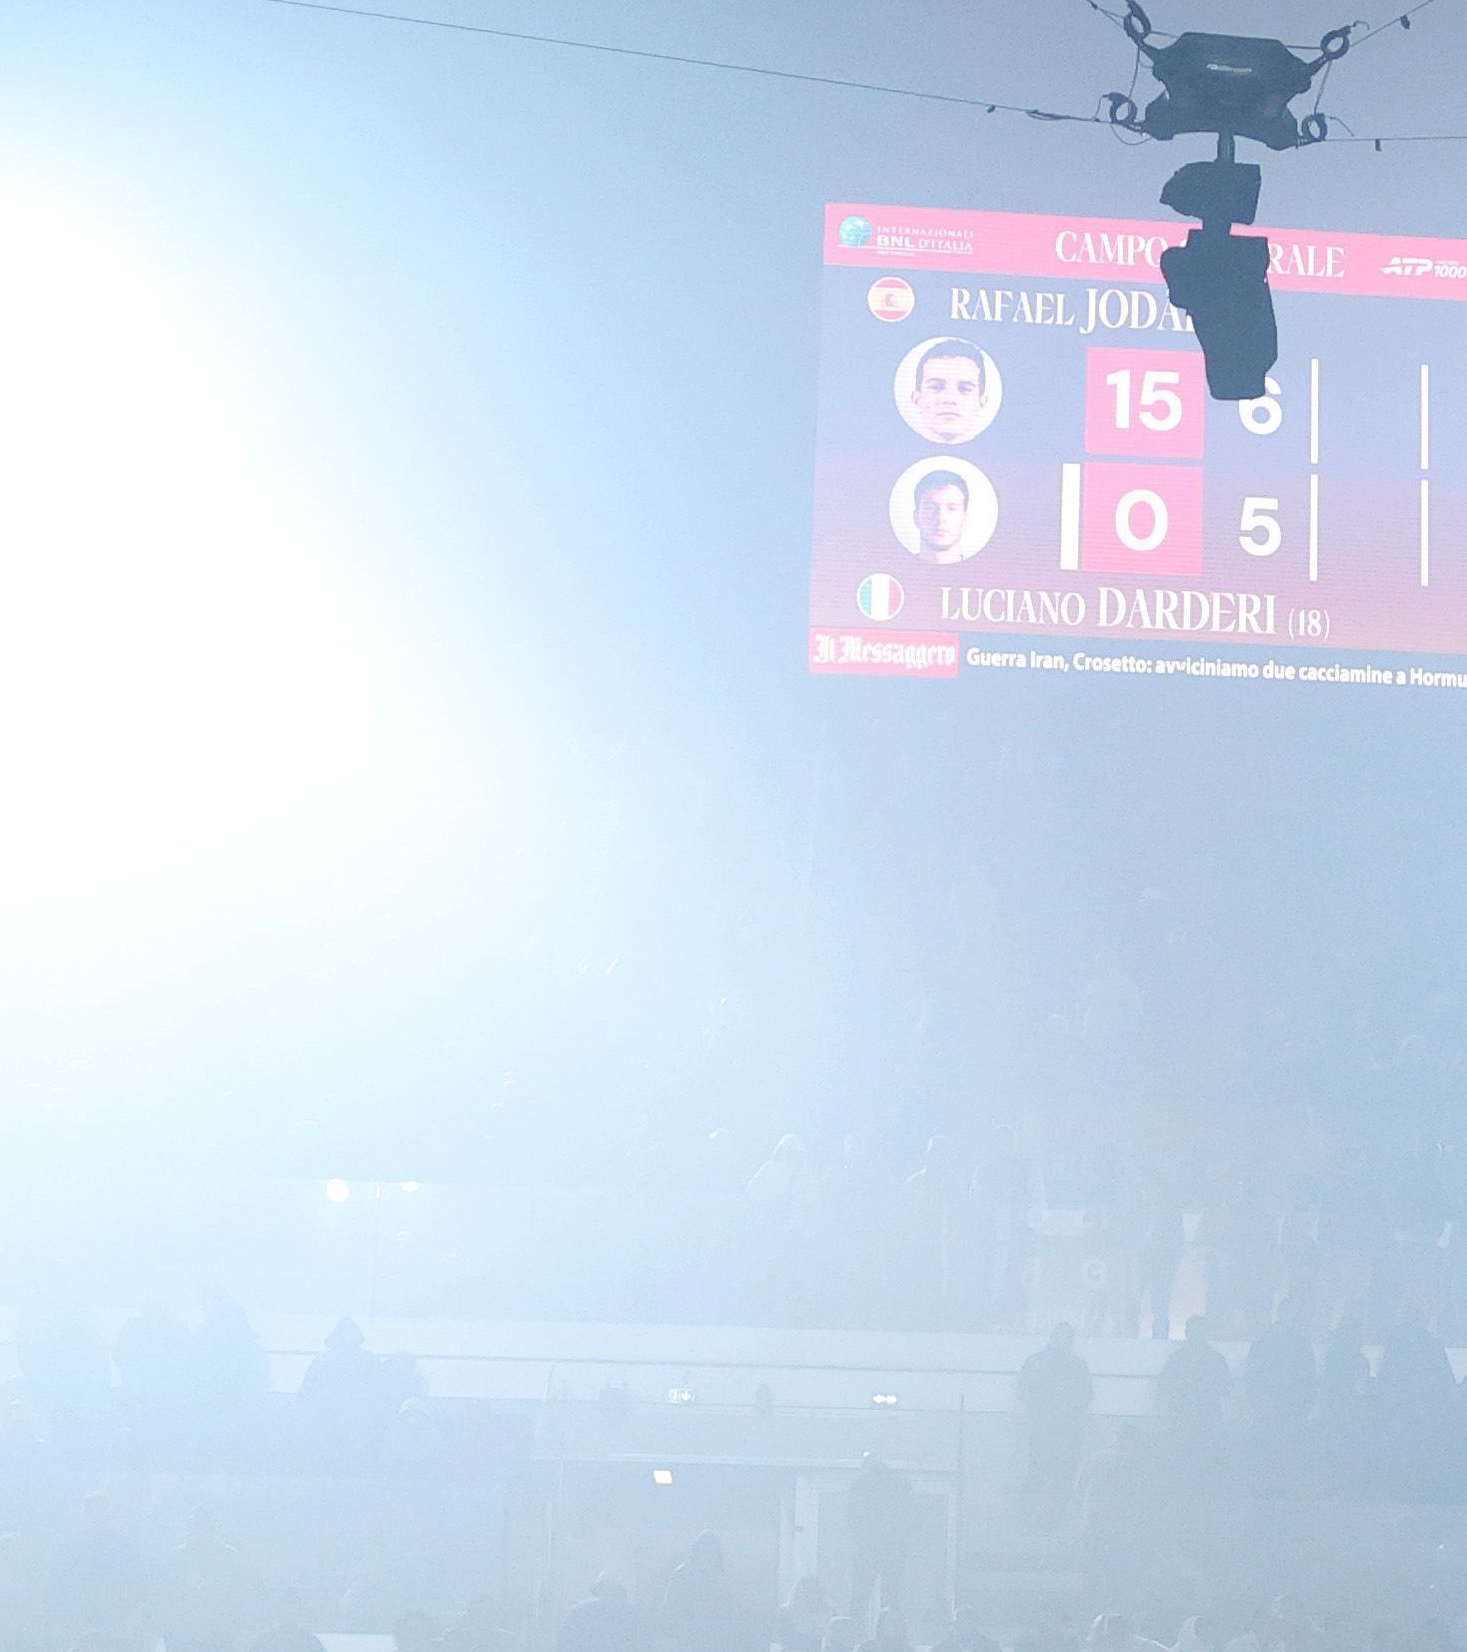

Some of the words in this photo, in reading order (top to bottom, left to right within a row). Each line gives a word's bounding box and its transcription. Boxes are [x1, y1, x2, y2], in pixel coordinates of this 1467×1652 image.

[877, 225, 973, 239] INTERNAZIONALI
[877, 235, 915, 249] BNL
[918, 237, 974, 252] D'ITALIA
[1381, 256, 1433, 277] ATP
[1434, 264, 1467, 280] 1000
[950, 287, 1075, 327] RAFAEL
[1106, 369, 1183, 432] 15
[1238, 376, 1283, 435] 6
[1115, 489, 1168, 551] 0
[1238, 496, 1282, 557] 5
[939, 586, 1085, 626] LUCIANO
[1098, 586, 1277, 635] DARDERI
[1288, 607, 1330, 640] (18)
[837, 634, 957, 670] Messaggero
[966, 647, 1027, 668] Guerra
[1030, 650, 1071, 673] Iran,
[1072, 652, 1153, 675] Crosetto:
[1154, 656, 1259, 679] avviciniamo
[1262, 659, 1296, 680] due
[1298, 662, 1393, 685] cacciamine
[1395, 671, 1408, 685] a
